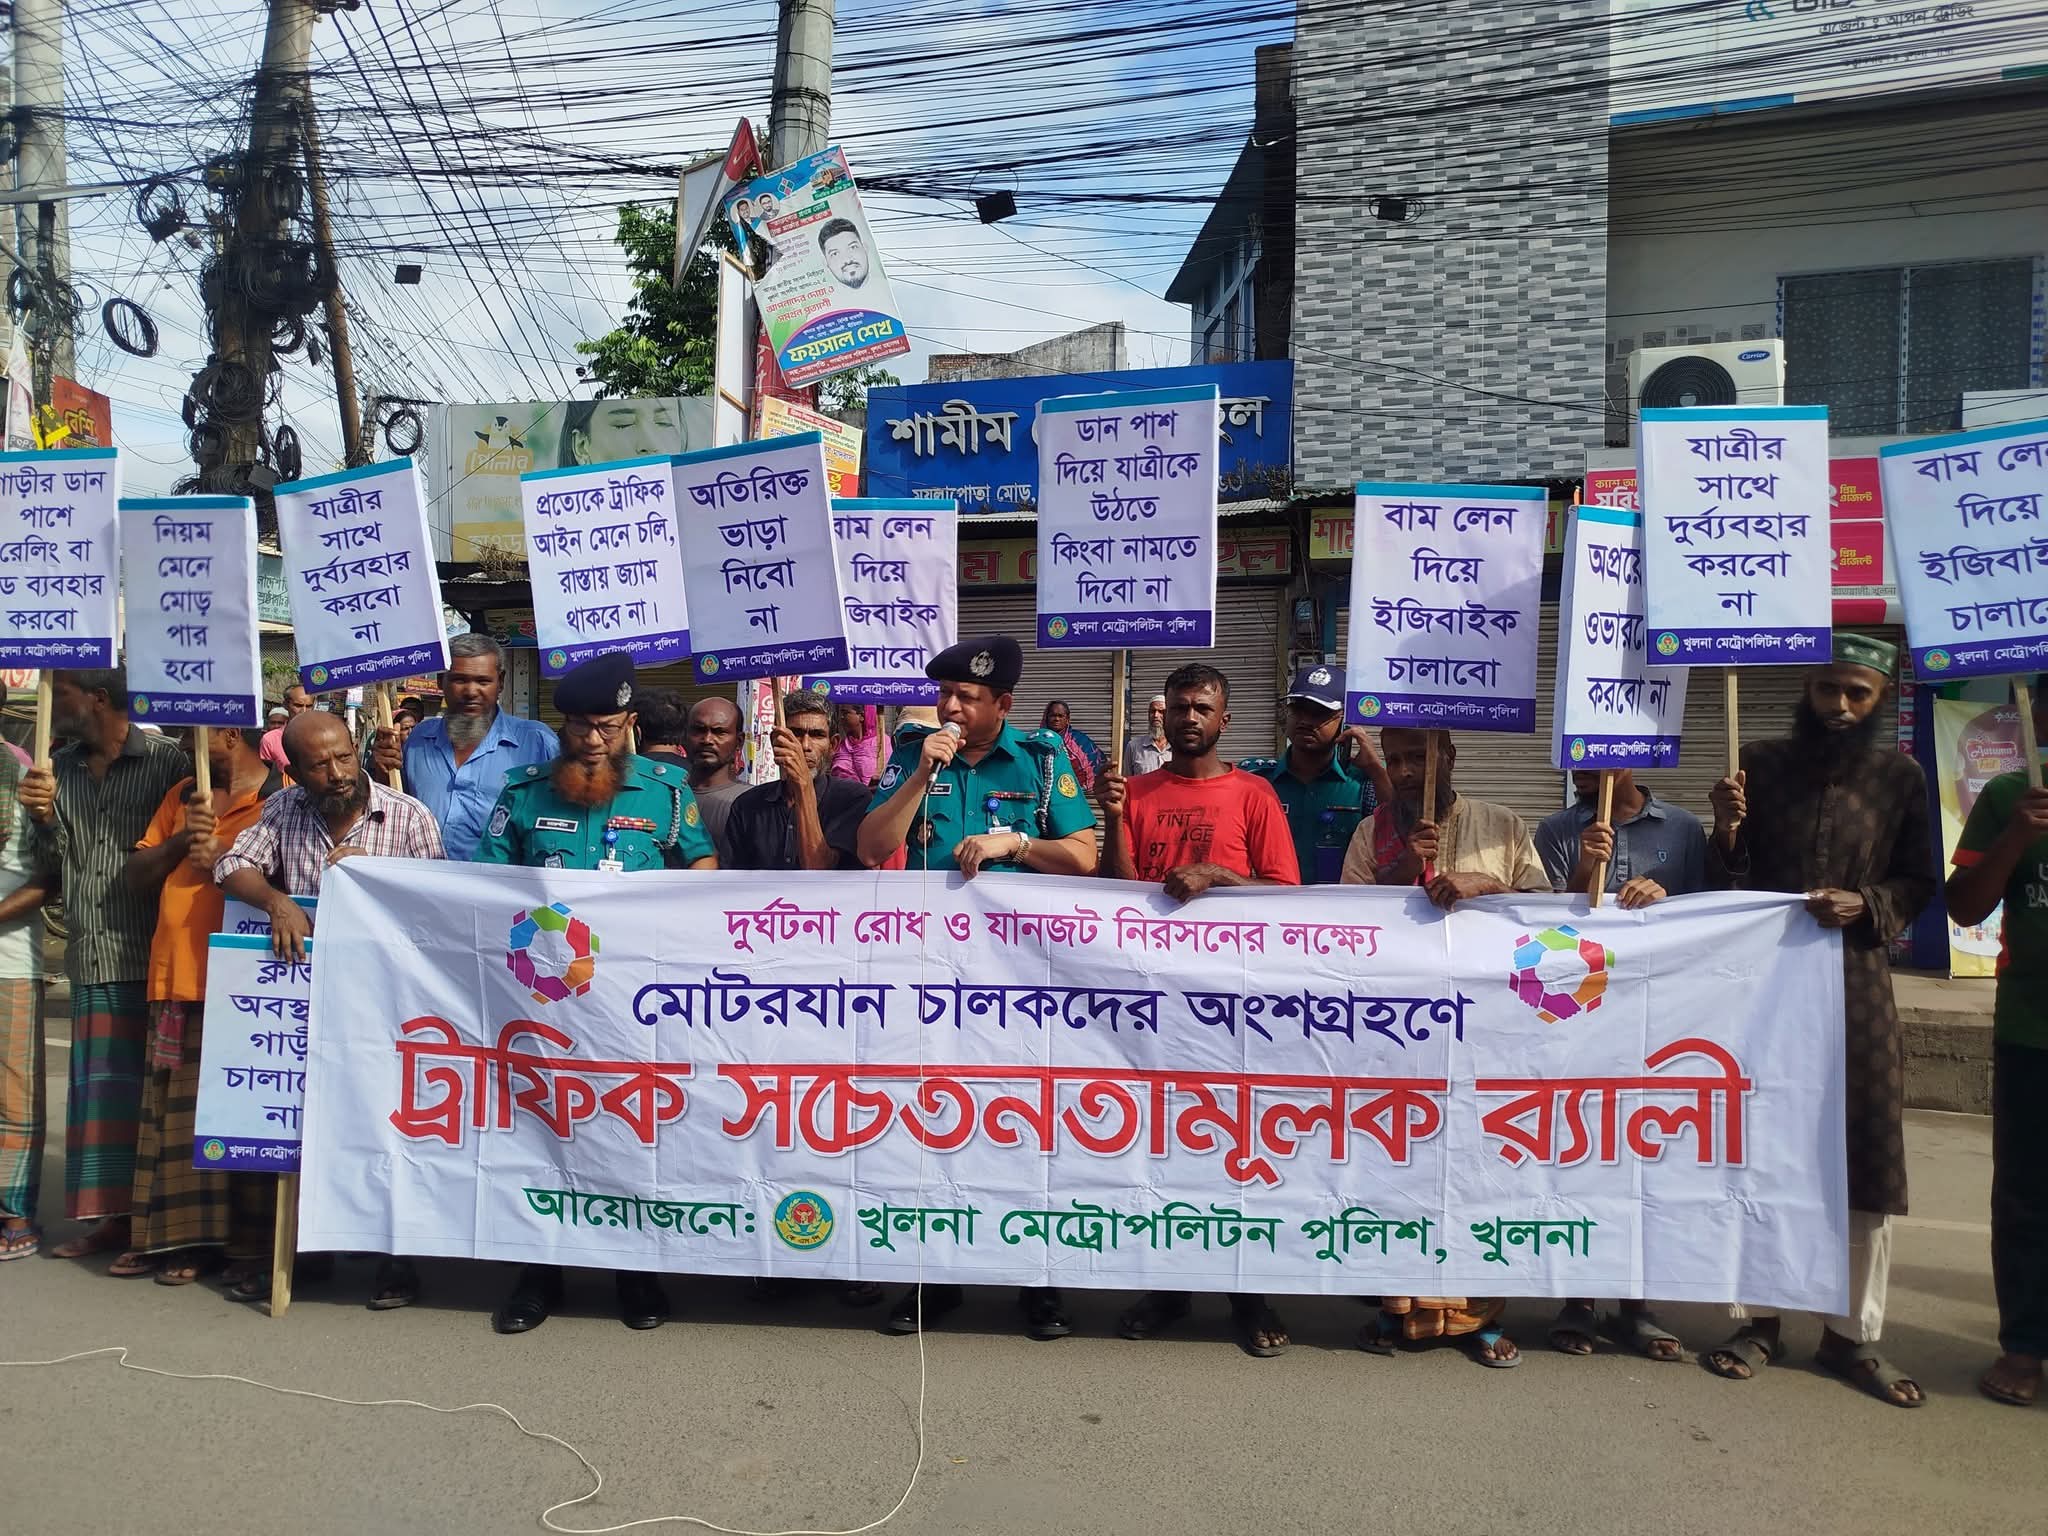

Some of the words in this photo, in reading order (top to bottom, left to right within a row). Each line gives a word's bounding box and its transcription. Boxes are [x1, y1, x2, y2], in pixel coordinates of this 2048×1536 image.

[788, 331, 856, 362] ফয়সাল
[857, 320, 893, 342] শেখ
[1741, 352, 1767, 360] Carrier
[886, 399, 1019, 457] শামীম
[1075, 414, 1122, 443] ডান
[1130, 408, 1181, 440] পাশ
[1686, 428, 1788, 463] যাত্রীর
[1054, 452, 1106, 486] দিয়ে
[1113, 445, 1202, 483] যাত্রীকে
[1912, 450, 1984, 483] বাম
[1998, 440, 2048, 472] লে
[62, 469, 107, 494] ডান
[536, 488, 605, 519] প্রত্যেকে
[608, 474, 666, 513] ট্রাফিক
[687, 465, 811, 511] অতিরিক্ত
[1695, 473, 1780, 500] সাথে
[1840, 484, 1857, 494] প্রিয়
[1840, 492, 1873, 502] এজেন্ট
[20, 504, 75, 529] পাশে
[308, 487, 383, 522] যাত্রীর
[1088, 488, 1160, 522] উঠতে
[1382, 501, 1443, 533] বাম
[1453, 506, 1520, 535] লেন
[1954, 493, 2044, 529] দিয়ে
[153, 514, 213, 545] নিয়ম
[319, 521, 382, 552] সাথে
[533, 524, 582, 558] আইন
[589, 521, 630, 552] মেনে
[635, 510, 676, 548] চলি,
[719, 513, 790, 552] ভাড়া
[883, 517, 936, 540] লেন
[1664, 506, 1812, 546] দুর্ব্যবহার
[67, 538, 93, 563] বা
[1051, 532, 1116, 567] কিংবা
[1122, 533, 1202, 565] নামতে
[1683, 550, 1792, 579] করবো
[1840, 548, 1857, 558] প্রিয়
[1840, 555, 1873, 566] এজেন্ট
[158, 555, 213, 579] মেনে
[300, 549, 411, 594] দুর্ব্যবহার
[558, 564, 609, 595] রাস্তায়
[614, 558, 658, 586] জ্যাম
[720, 556, 797, 595] নিবো
[849, 552, 910, 584] দিয়ে
[1409, 546, 1485, 585] দিয়ে
[24, 572, 105, 599] ব্যবহার
[319, 582, 402, 617] করবো
[1075, 571, 1138, 606] দিবো
[1143, 575, 1173, 603] না
[160, 588, 212, 617] মোড়
[1370, 596, 1521, 639] ইজিবাইক
[1717, 590, 1758, 618] না
[6, 608, 79, 632] করবো
[350, 618, 382, 646] না
[566, 603, 621, 634] থাকবে
[745, 603, 781, 635] না
[1071, 618, 1099, 638] খুলনা
[1101, 616, 1164, 636] মেট্রোপলিটন
[1167, 615, 1197, 637] পুলিশ
[23, 643, 74, 658] মেট্রোপলিটন
[76, 643, 101, 659] পুলিশ
[168, 623, 209, 650] পার
[570, 647, 594, 665] খুলনা
[654, 637, 680, 652] পুলিশ
[1683, 635, 1713, 653] খুলনা
[1716, 632, 1782, 652] মেট্রোপলিটন
[1784, 634, 1816, 653] পুলিশ
[162, 658, 215, 684] হবো
[330, 663, 353, 681] খুলনা
[355, 654, 407, 678] মেট্রোপলিটন
[406, 649, 432, 671] পুলিশ
[723, 655, 748, 674] খুলনা
[749, 647, 806, 671] মেট্রোপলিটন
[808, 645, 835, 665] পুলিশ
[850, 644, 929, 671] ালাবো
[1384, 654, 1502, 690] চালাবো
[1954, 649, 1990, 667] খুলনা
[833, 684, 858, 697] খুলনা
[860, 681, 915, 696] মেট্রোপলিটন
[1586, 672, 1645, 718] করবো
[1649, 673, 1671, 719] না
[150, 698, 173, 714] খুলনা
[173, 697, 221, 714] মেট্রোপলিটন
[221, 698, 245, 716] পুলিশ
[1385, 700, 1414, 717] খুলনা
[1418, 700, 1485, 720] মেট্রোপলিটন
[1489, 703, 1520, 721] পুলিশ
[1587, 743, 1608, 759] খুলনা
[1609, 739, 1652, 757] মেট্রোপলিটন
[1652, 740, 1672, 759] পুলিশ
[1180, 824, 1214, 842] AGE
[1150, 842, 1166, 857] 87
[724, 897, 841, 954] দুর্ঘটনা
[854, 906, 932, 947] রোধ
[944, 913, 972, 943] ও
[985, 903, 1104, 949] যানজট
[1112, 906, 1270, 955] নিরসনের
[1278, 920, 1383, 958] লক্ষ্যে
[632, 966, 897, 1030] মোটরযান
[906, 977, 1168, 1035] চালকদের
[1184, 987, 1477, 1049] অংশগ্রহণে
[389, 1014, 693, 1147] ট্রাফিক
[716, 1060, 1450, 1189] সচেতনতামূলক
[261, 1104, 303, 1131] না
[229, 1144, 256, 1159] খুলনা
[857, 1201, 984, 1252] খুলনা
[999, 1198, 1285, 1254] মেট্রোপলিটন
[1301, 1206, 1449, 1266] পুলিশ,
[1469, 1214, 1599, 1266] খুলনা
